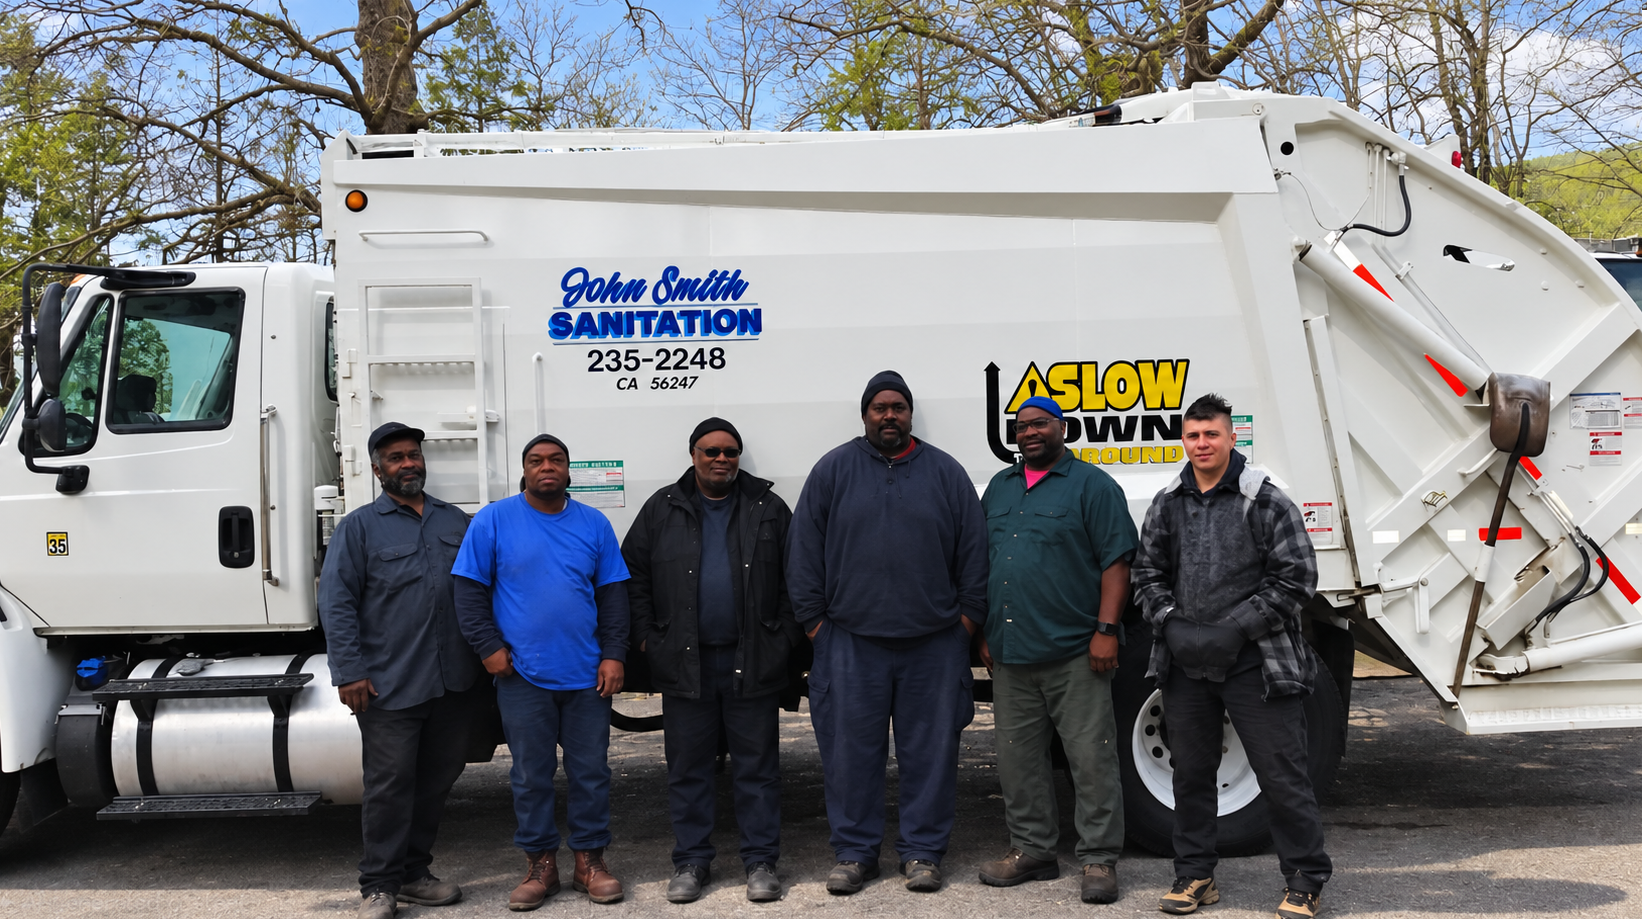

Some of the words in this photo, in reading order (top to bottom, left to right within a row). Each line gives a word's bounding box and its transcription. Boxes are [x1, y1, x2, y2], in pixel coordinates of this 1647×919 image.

[561, 267, 647, 308] John
[652, 265, 749, 305] Smith
[548, 308, 762, 340] SANITATION
[587, 347, 726, 372] 235-2248
[616, 377, 639, 391] CA
[650, 376, 699, 390] 56247
[1047, 358, 1190, 412] SLOW
[1006, 414, 1183, 444] OWN
[49, 538, 66, 553] 35
